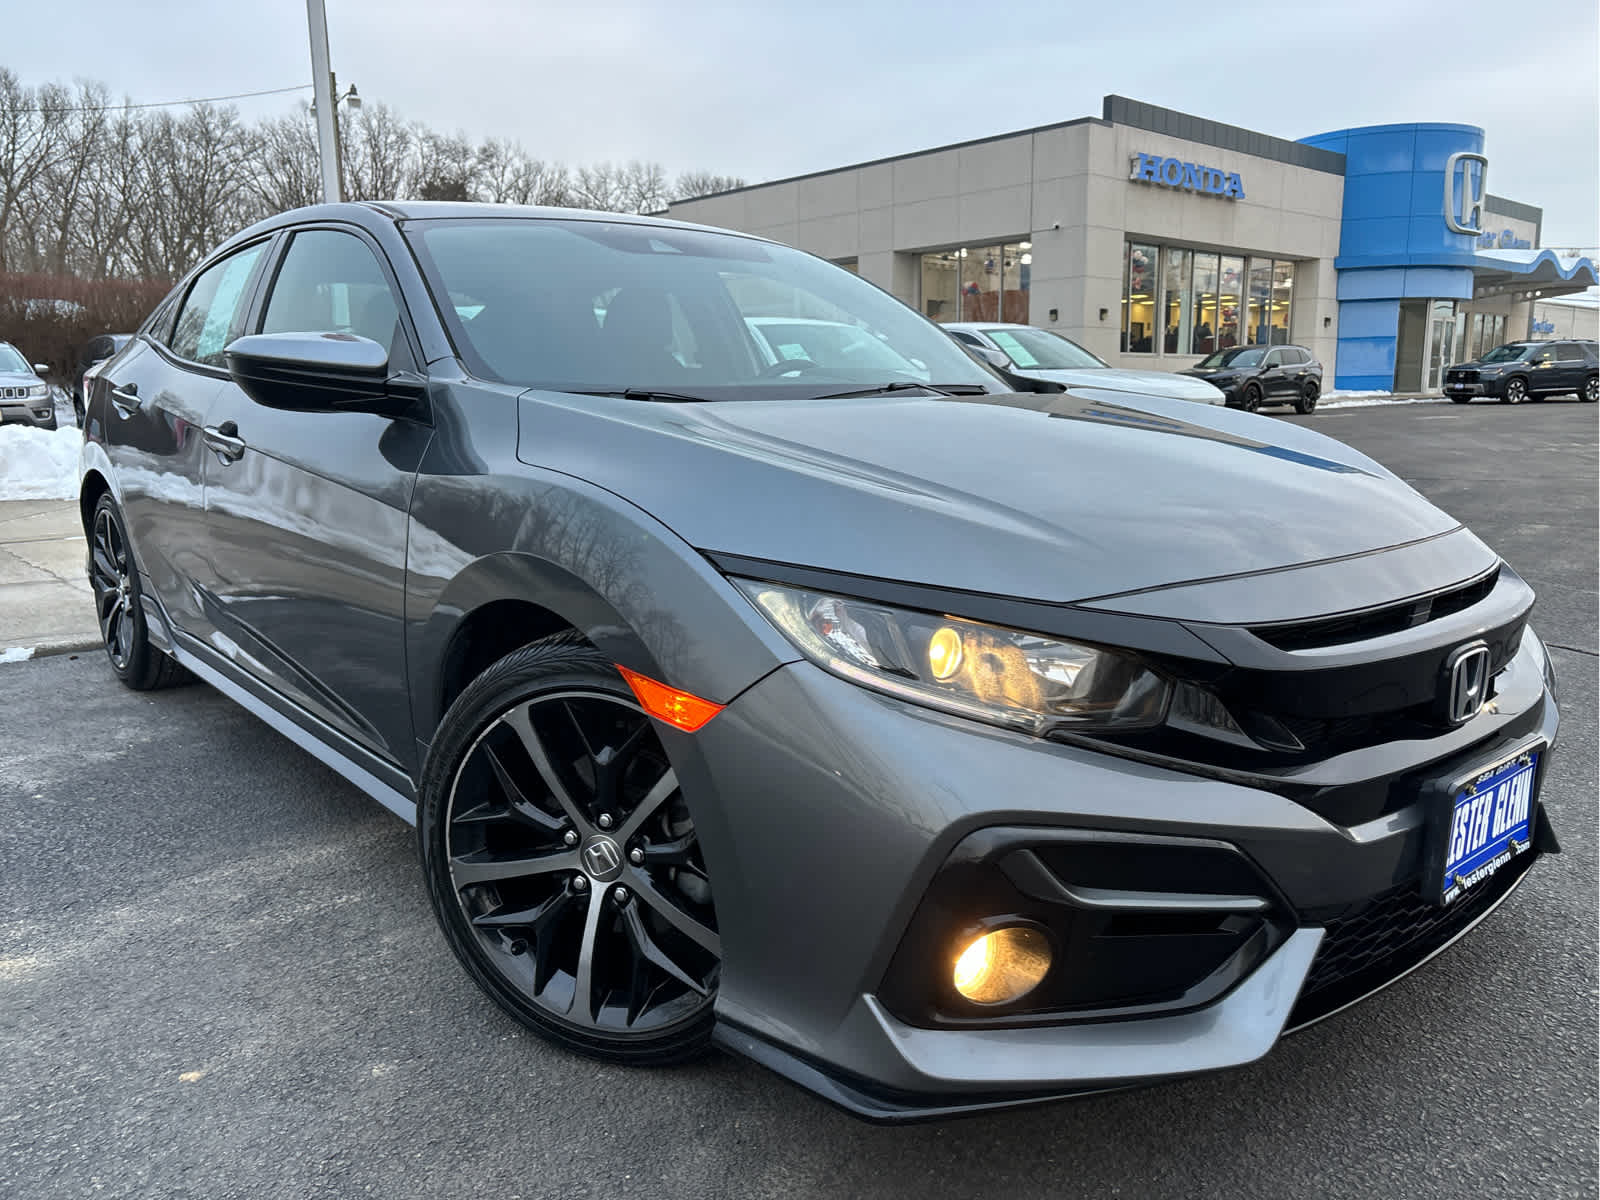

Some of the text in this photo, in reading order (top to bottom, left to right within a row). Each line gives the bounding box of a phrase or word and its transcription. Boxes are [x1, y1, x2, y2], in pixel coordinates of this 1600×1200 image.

[1135, 152, 1246, 199] HONDA
[1492, 767, 1534, 839] GLENN
[1463, 852, 1512, 889] lesterglenn
